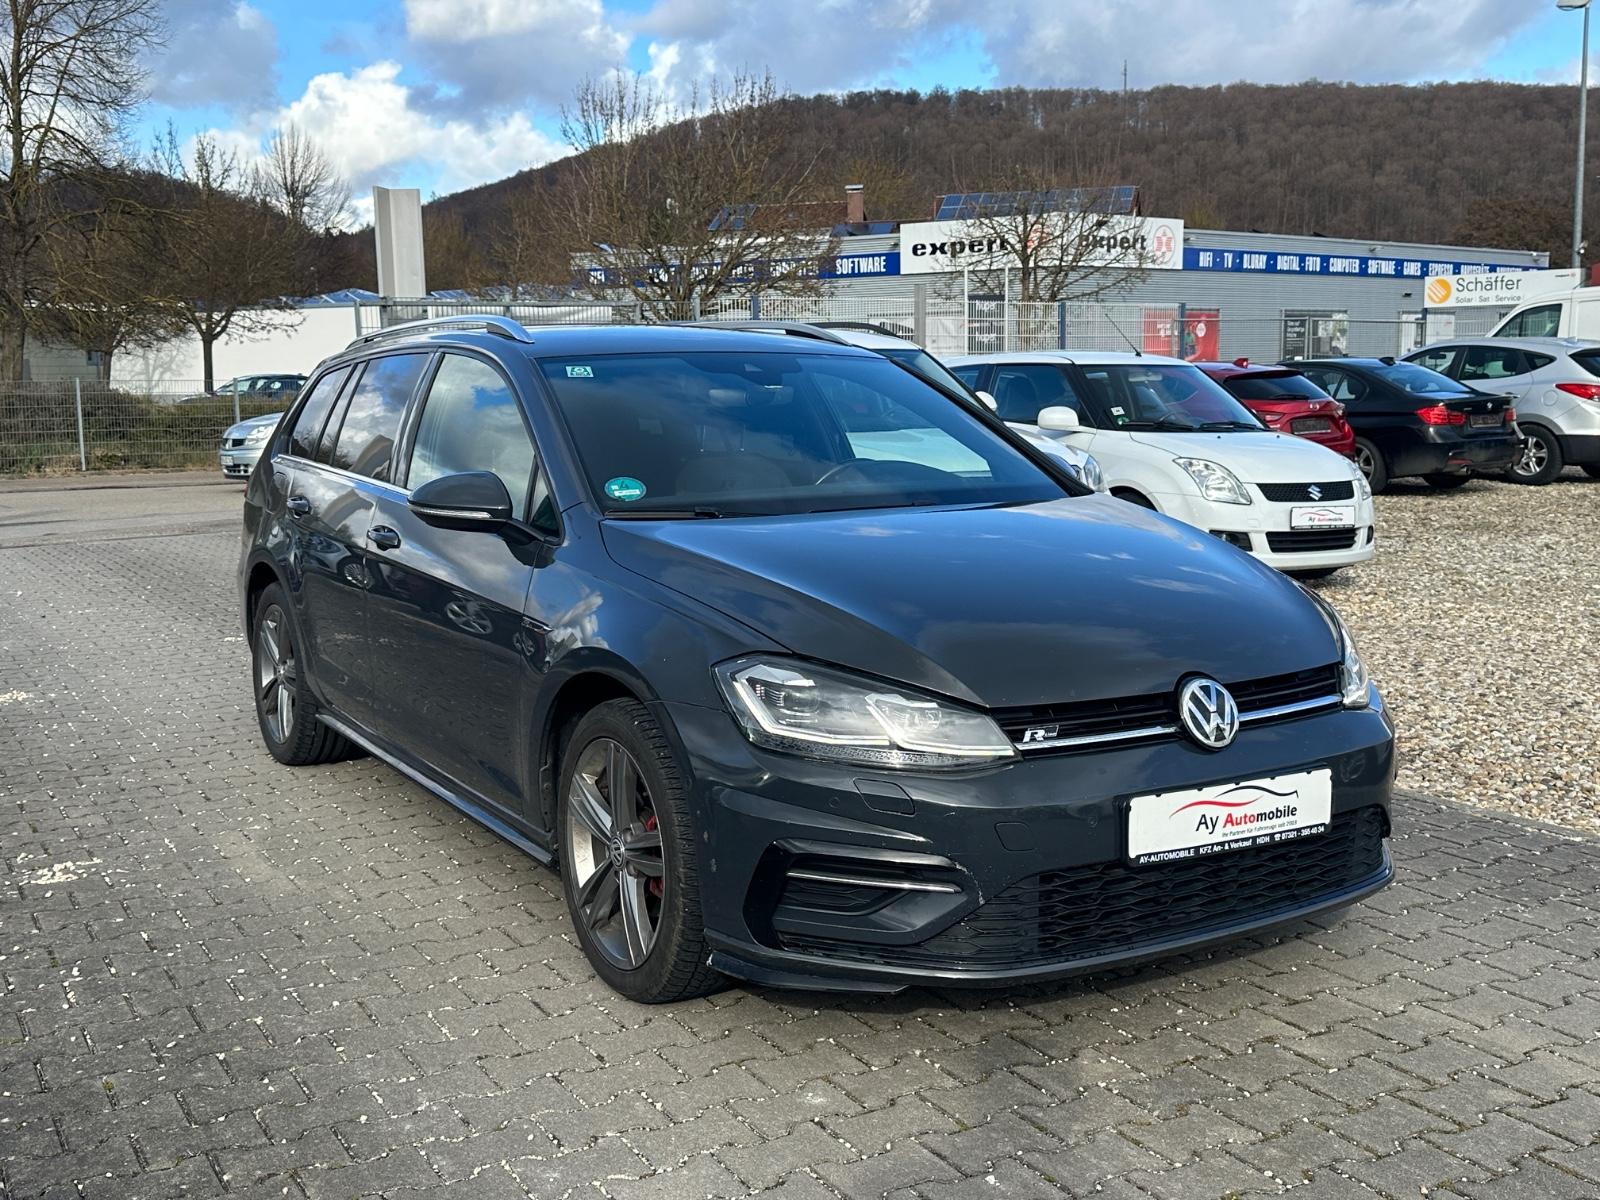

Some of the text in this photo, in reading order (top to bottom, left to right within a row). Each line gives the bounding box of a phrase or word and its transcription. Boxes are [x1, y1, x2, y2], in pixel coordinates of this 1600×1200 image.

[835, 256, 886, 275] SOFTWARE
[1223, 252, 1233, 268] TV
[1329, 257, 1359, 273] COMPUTER
[1367, 259, 1396, 275] SOFTWARE
[1456, 275, 1522, 293] Schäffer
[1455, 294, 1522, 304] Solar Sat Service
[1195, 804, 1298, 835] Ay Automobile
[1139, 848, 1195, 865] AY-AUTOMOBILE
[1199, 846, 1212, 855] KFZ
[1212, 843, 1224, 853] An-
[1224, 842, 1230, 850] &
[1230, 839, 1253, 850] Verkauf
[1256, 835, 1270, 845] HDH
